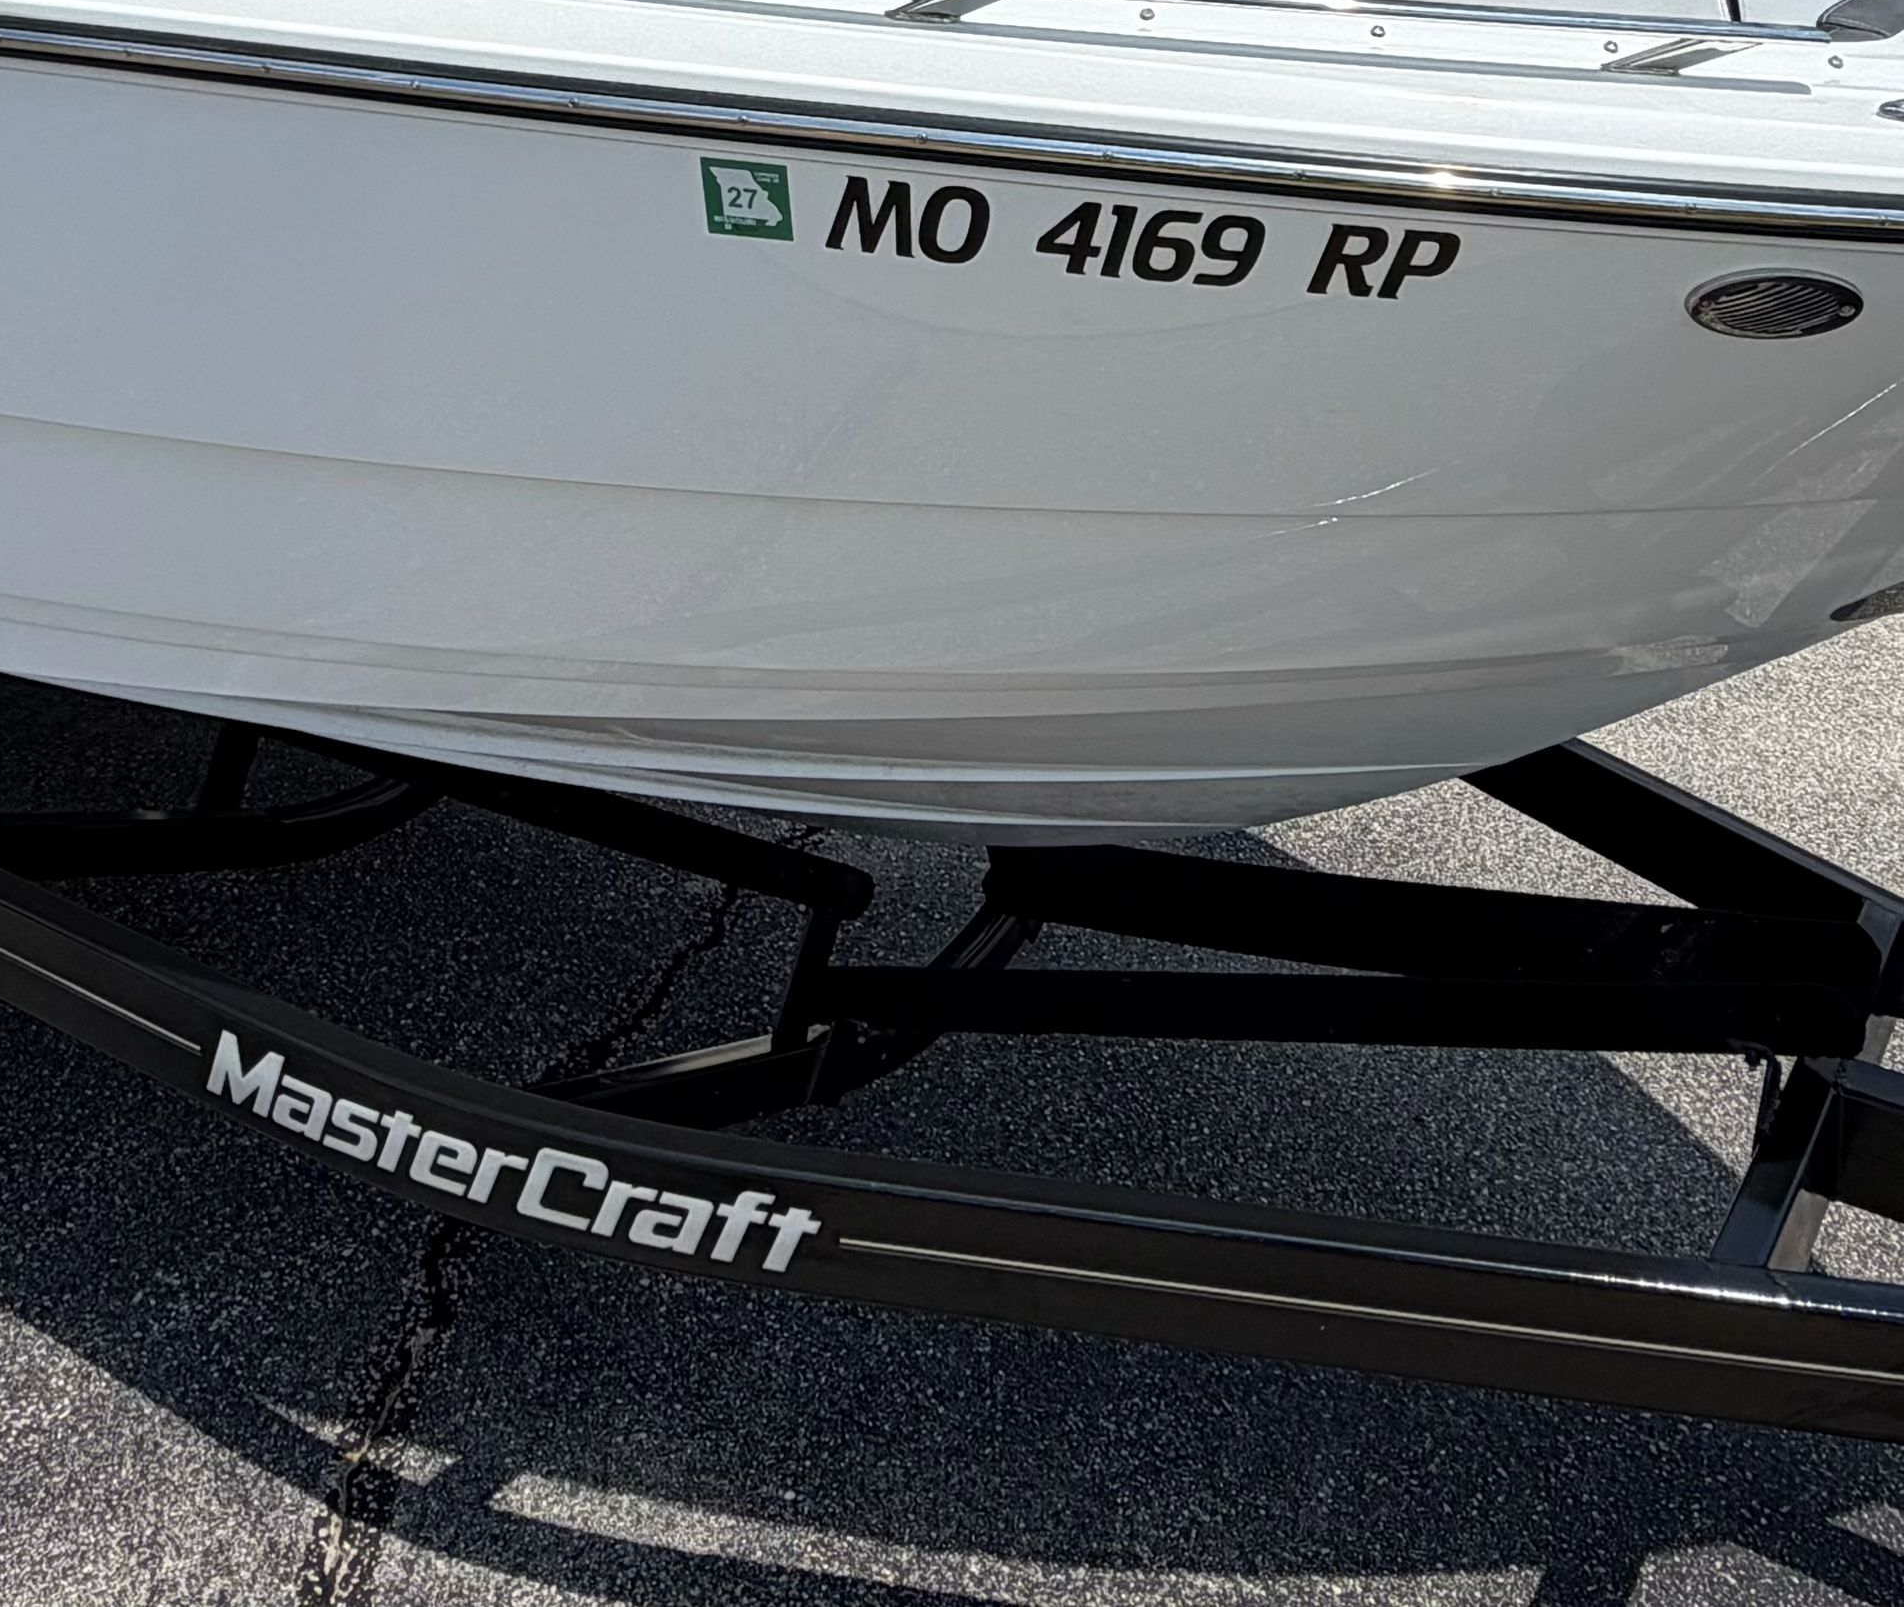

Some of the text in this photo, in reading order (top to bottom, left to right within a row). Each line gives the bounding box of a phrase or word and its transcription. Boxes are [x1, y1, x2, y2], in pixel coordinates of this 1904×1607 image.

[727, 186, 758, 210] 27
[826, 176, 1462, 300] MO 4169 RP
[207, 1030, 822, 1272] MasterCraft
